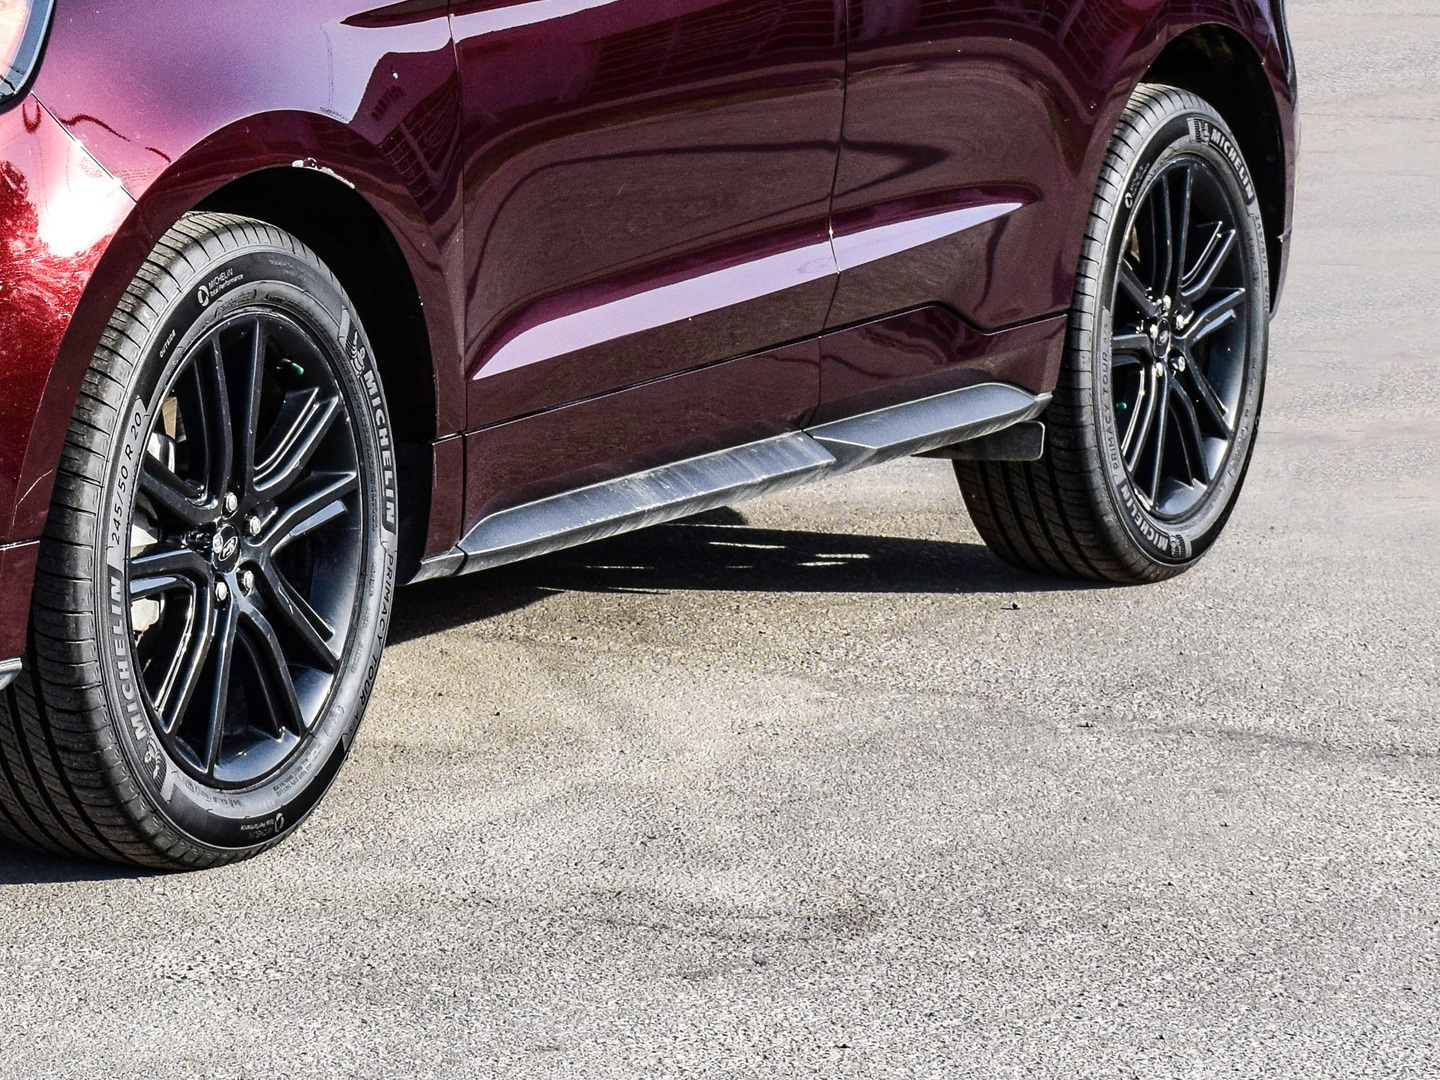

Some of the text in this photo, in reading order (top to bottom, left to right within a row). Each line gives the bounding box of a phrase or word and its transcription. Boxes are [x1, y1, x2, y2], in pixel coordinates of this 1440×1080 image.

[1211, 127, 1254, 200] MICHELIN
[159, 329, 177, 358] OUTSIDE
[1101, 351, 1110, 396] TOUR
[365, 371, 396, 524] MICHELIN
[1105, 403, 1120, 471] PRIMACY
[111, 411, 142, 546] 245/50 R 20
[1120, 485, 1169, 552] MICHELIN
[371, 555, 394, 652] PRIMACY
[108, 574, 149, 743] MICHELIN
[360, 655, 381, 709] TOUR
